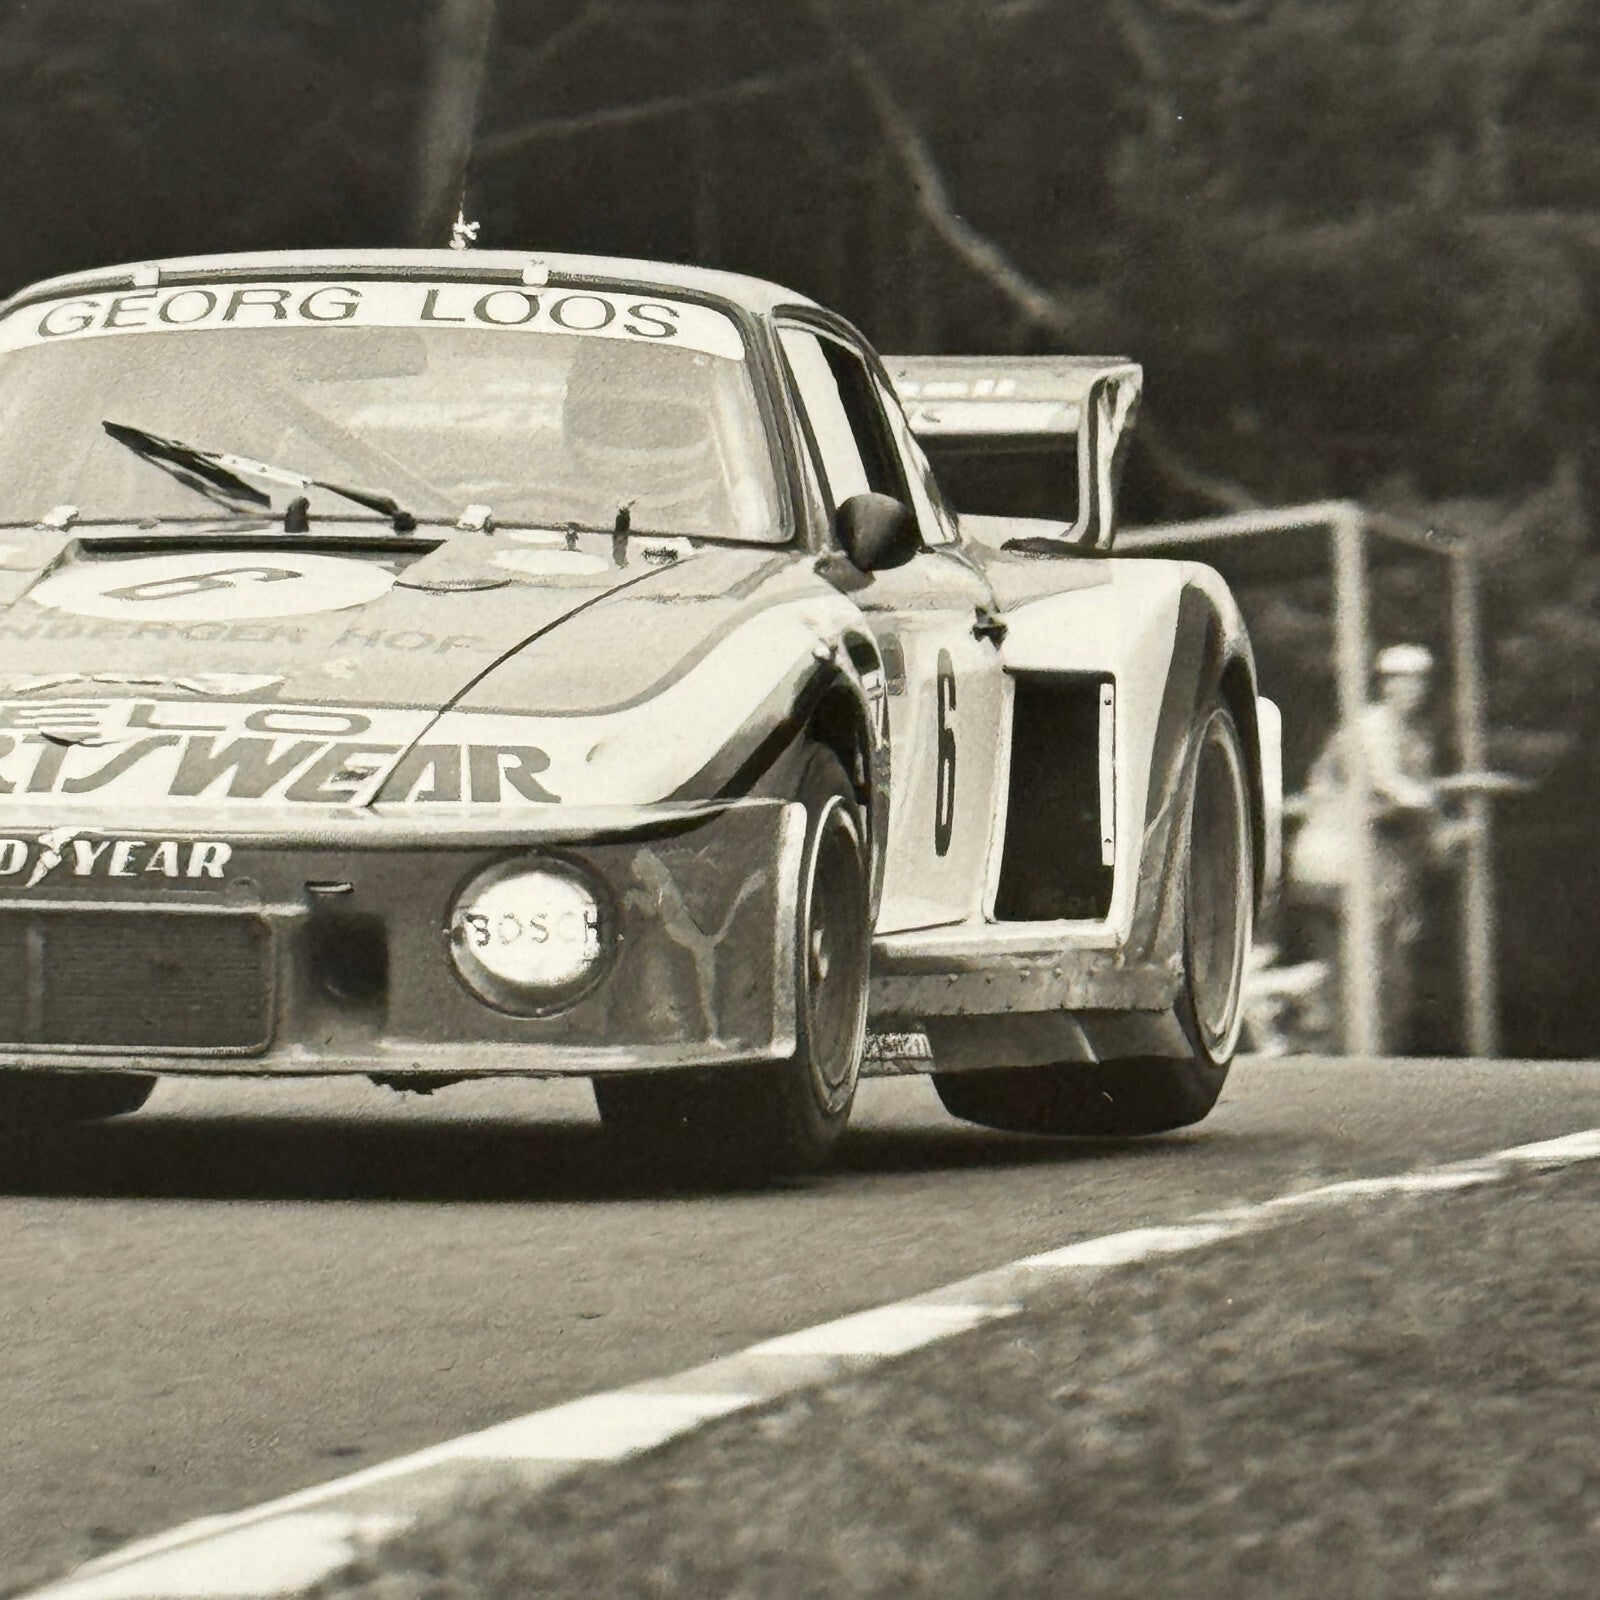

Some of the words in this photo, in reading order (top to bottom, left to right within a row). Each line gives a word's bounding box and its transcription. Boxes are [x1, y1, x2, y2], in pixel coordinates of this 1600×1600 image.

[37, 286, 363, 338] GEORG
[420, 289, 680, 339] LOOS
[100, 566, 305, 601] 6
[0, 734, 562, 803] TSWEAR
[935, 648, 957, 857] 6
